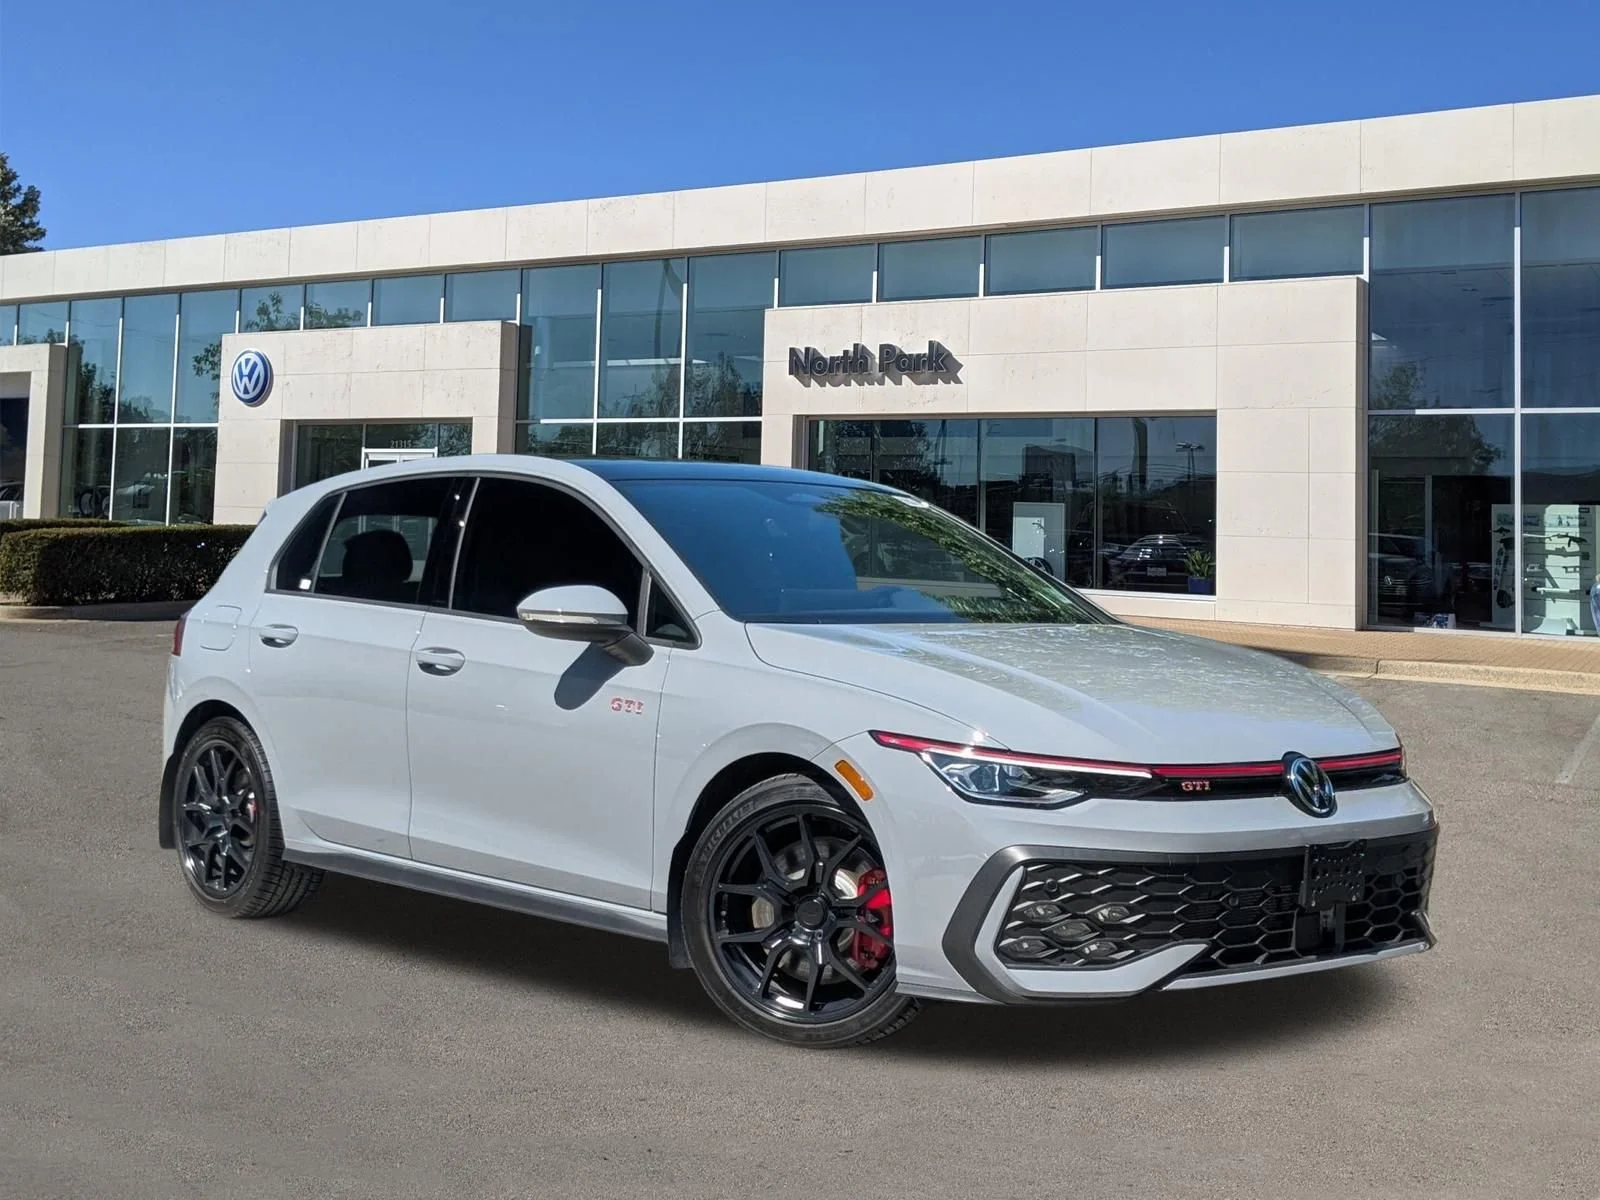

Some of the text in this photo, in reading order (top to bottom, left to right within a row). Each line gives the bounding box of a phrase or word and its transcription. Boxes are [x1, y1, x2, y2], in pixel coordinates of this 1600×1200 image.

[788, 340, 946, 375] North Park
[233, 352, 266, 401] VW
[610, 697, 644, 715] GTI
[1181, 780, 1211, 791] GTI
